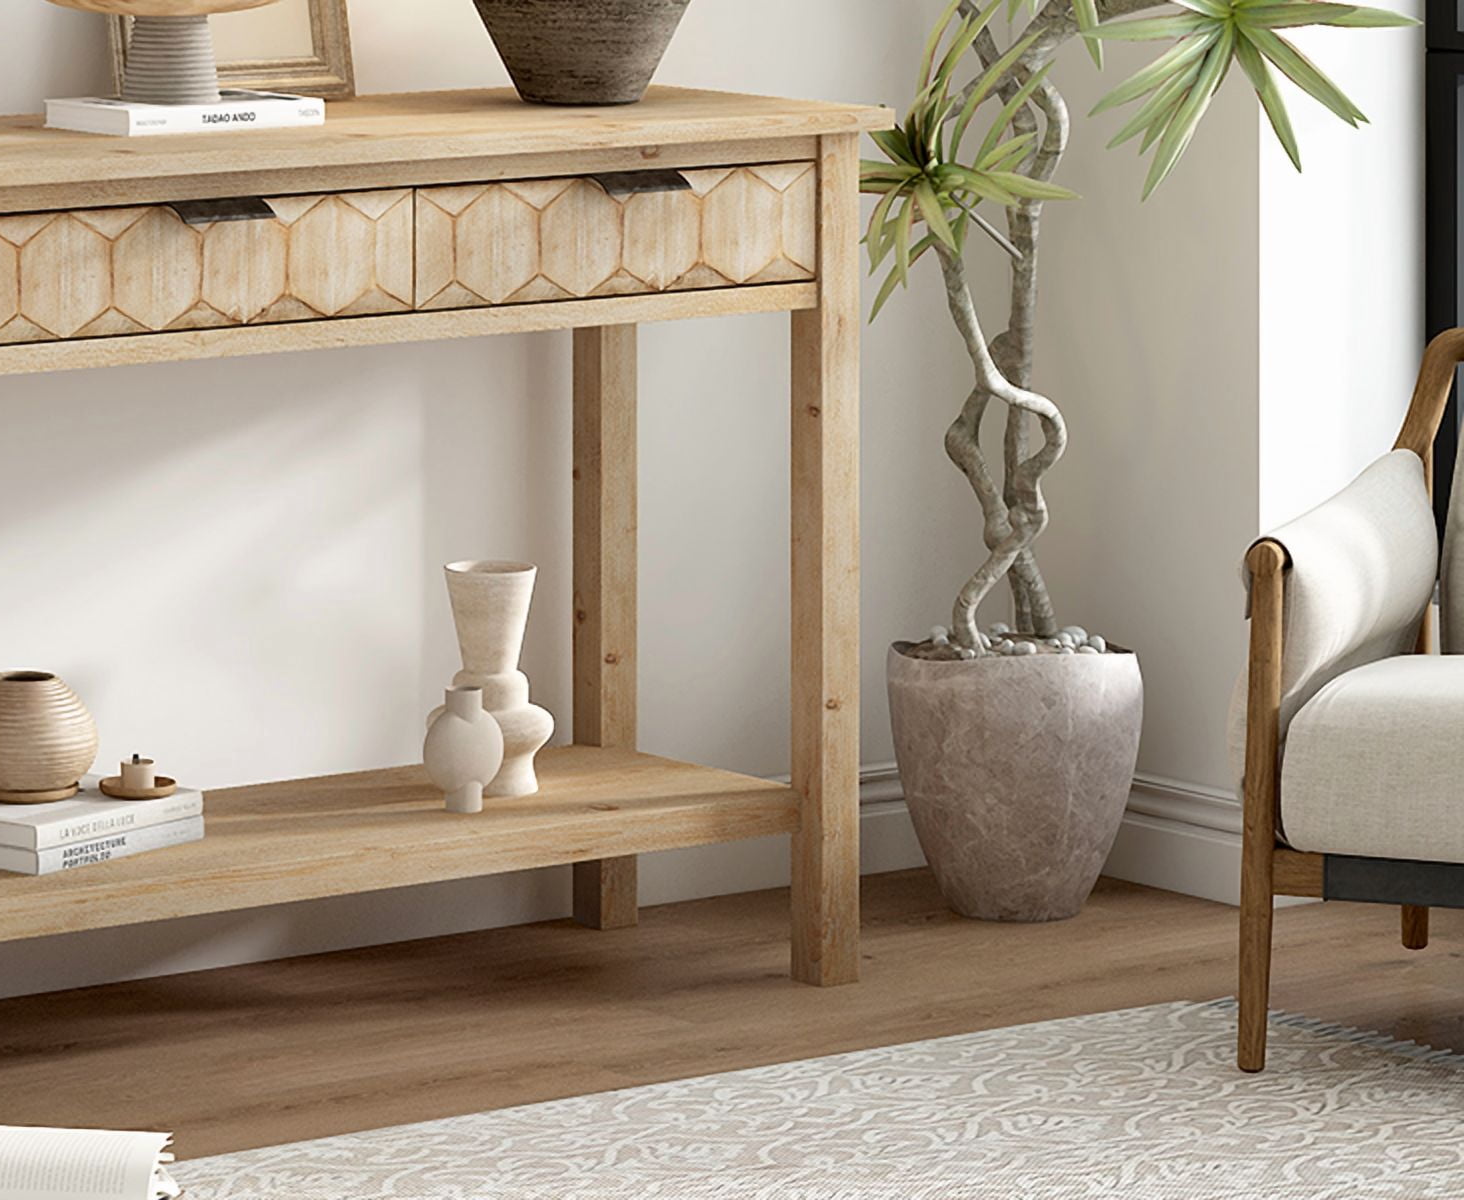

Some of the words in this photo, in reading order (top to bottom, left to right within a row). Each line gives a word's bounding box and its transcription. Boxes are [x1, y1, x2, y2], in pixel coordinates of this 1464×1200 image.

[202, 113, 230, 125] TADAO
[232, 112, 256, 123] ANDO
[59, 827, 70, 840] LA
[62, 836, 127, 858] ARCHITECTURE
